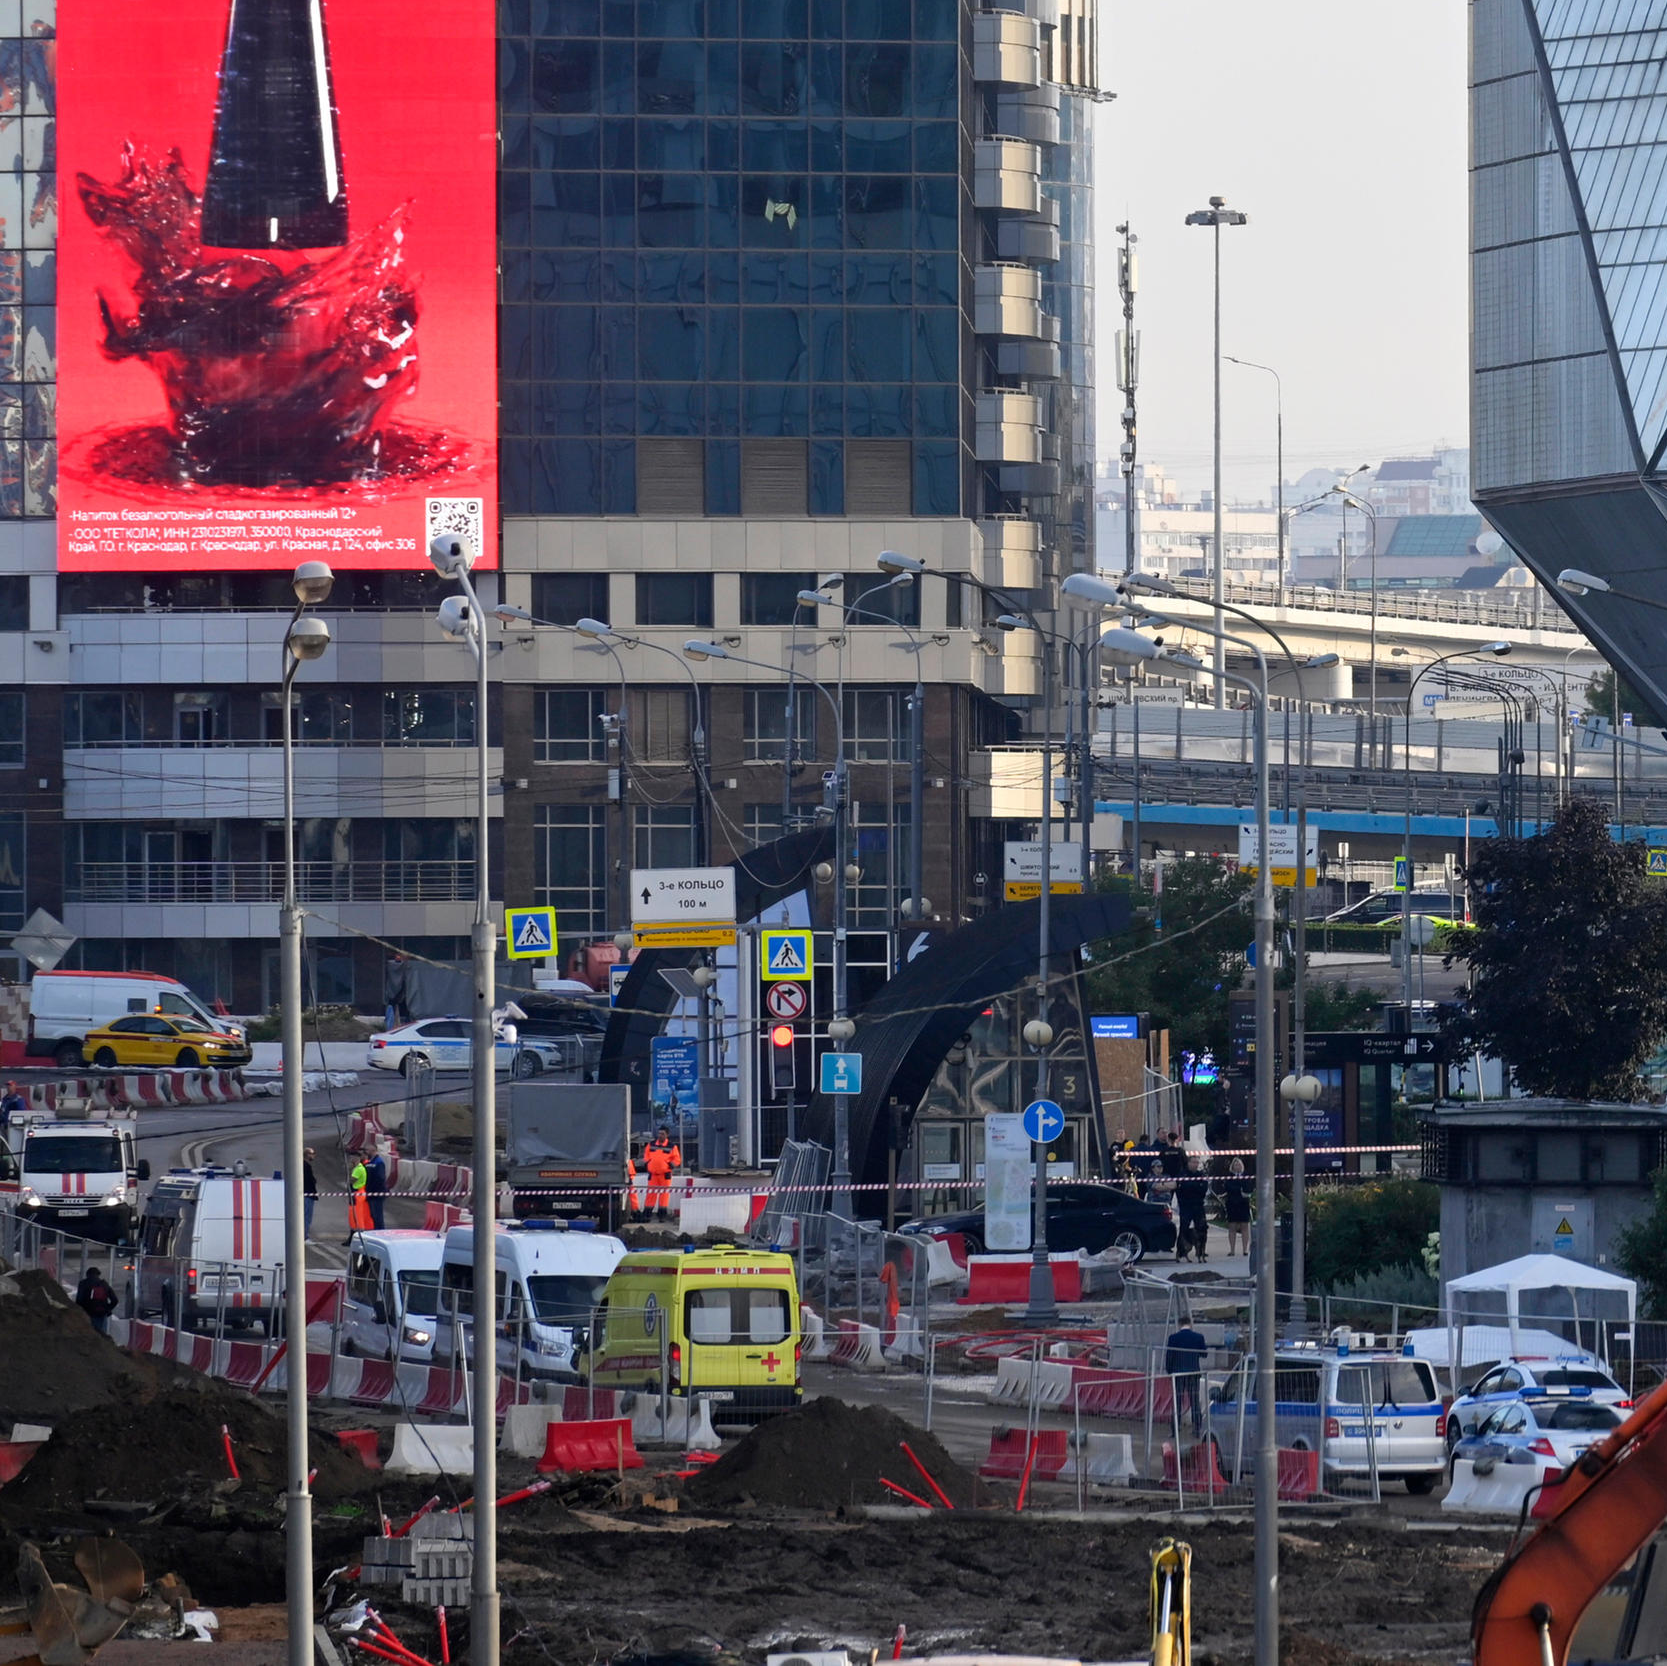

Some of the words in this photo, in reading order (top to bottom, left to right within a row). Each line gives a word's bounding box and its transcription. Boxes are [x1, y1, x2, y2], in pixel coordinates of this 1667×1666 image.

[121, 508, 213, 521] безалкогольный
[215, 508, 338, 521] сладкогазированный
[340, 507, 357, 519] 12+
[74, 528, 101, 539] ООО
[163, 527, 189, 538] ИНН
[295, 526, 382, 538] Краснодарский
[365, 539, 393, 551] офис
[395, 538, 416, 550] 306
[659, 881, 675, 890] 3-е
[678, 879, 725, 890] КОЛЬЦО
[678, 899, 696, 908] 100
[1063, 1076, 1076, 1094] 3
